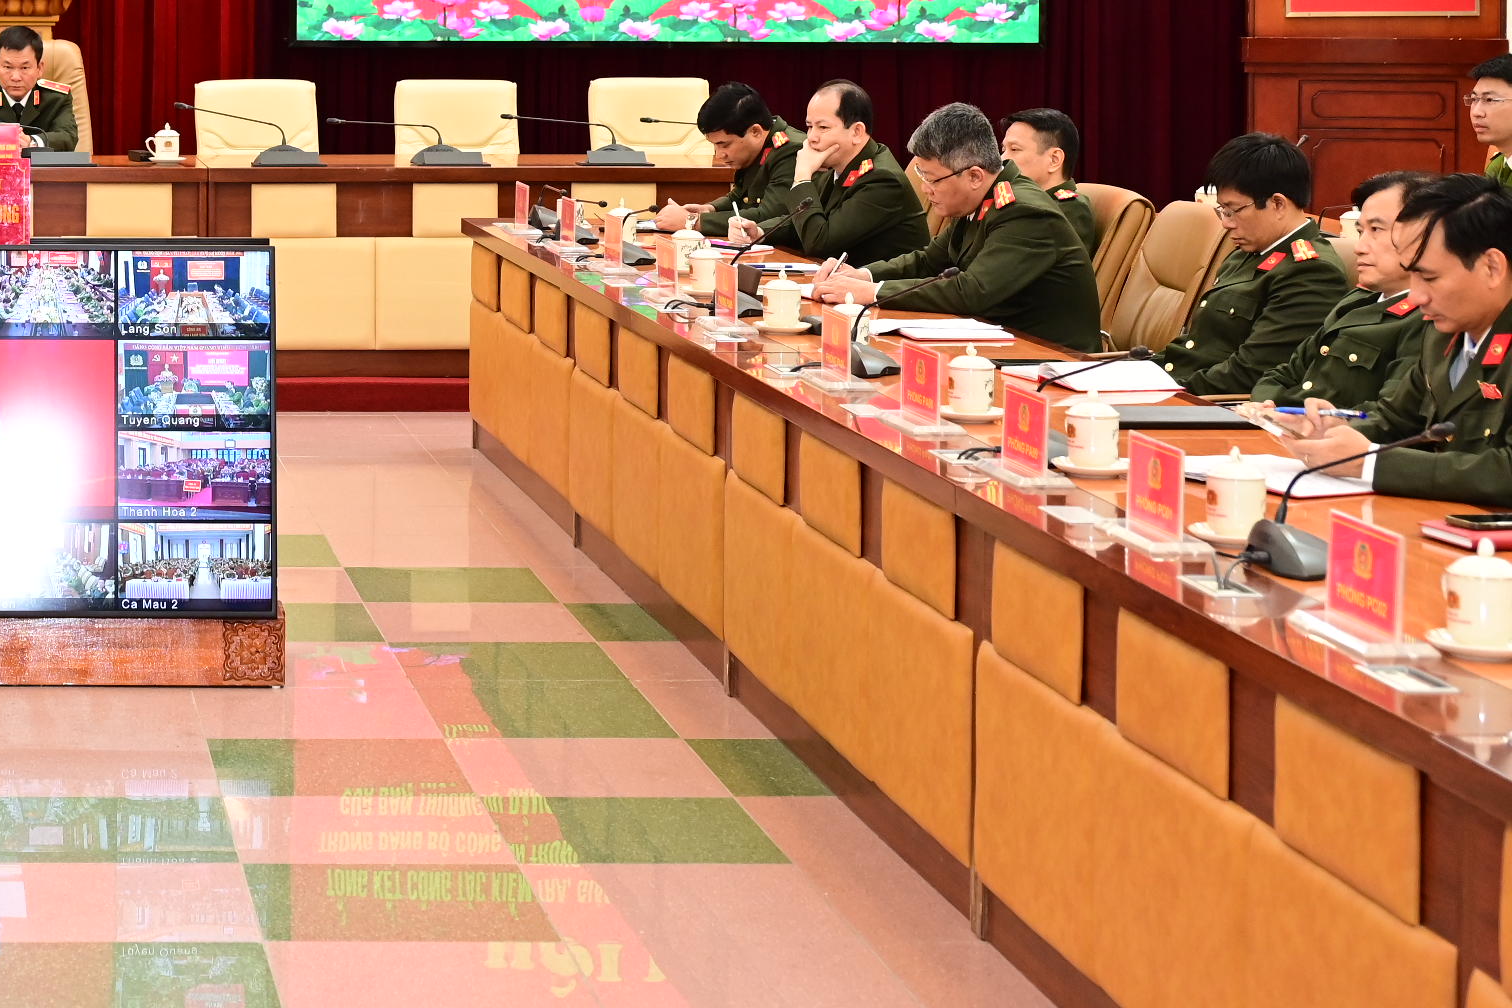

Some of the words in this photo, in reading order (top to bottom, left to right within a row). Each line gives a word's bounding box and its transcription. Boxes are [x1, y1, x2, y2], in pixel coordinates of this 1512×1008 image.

[122, 324, 151, 336] Lang
[154, 324, 177, 334] Son
[122, 415, 157, 427] Tuyen
[162, 415, 200, 427] Quang
[122, 506, 158, 517] Thanh
[163, 506, 185, 517] Hoa
[190, 506, 197, 517] 2
[122, 599, 138, 610] Ca
[142, 599, 166, 610] Mau
[170, 599, 178, 610] 2
